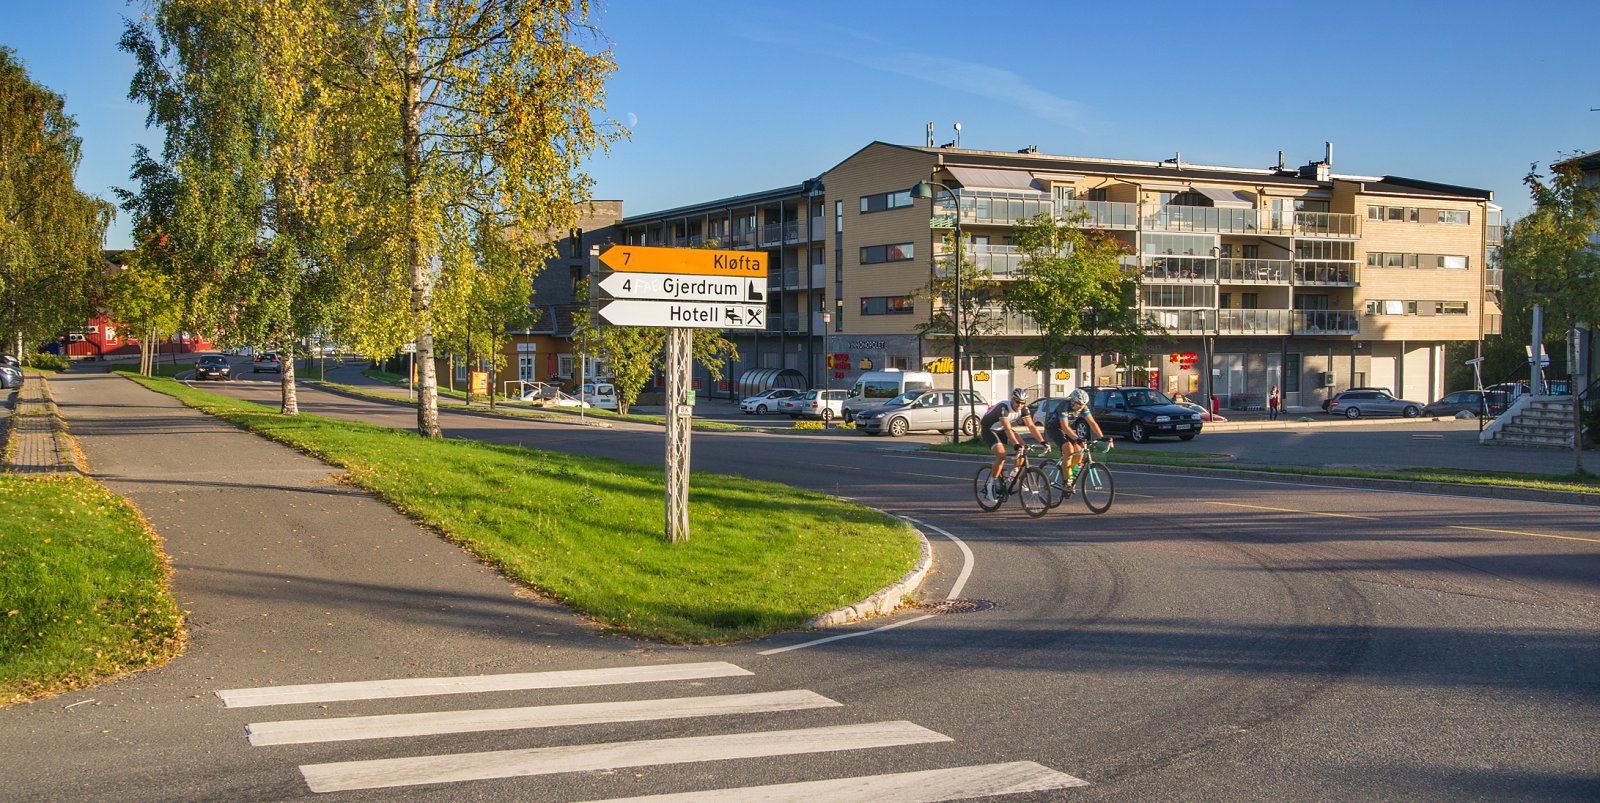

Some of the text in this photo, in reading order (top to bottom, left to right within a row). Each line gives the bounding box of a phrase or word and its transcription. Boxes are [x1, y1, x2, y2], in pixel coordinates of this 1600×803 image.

[622, 252, 760, 271] 7 Kløfta
[622, 278, 738, 297] 4 Gjerdrum
[670, 306, 719, 322] Hotell
